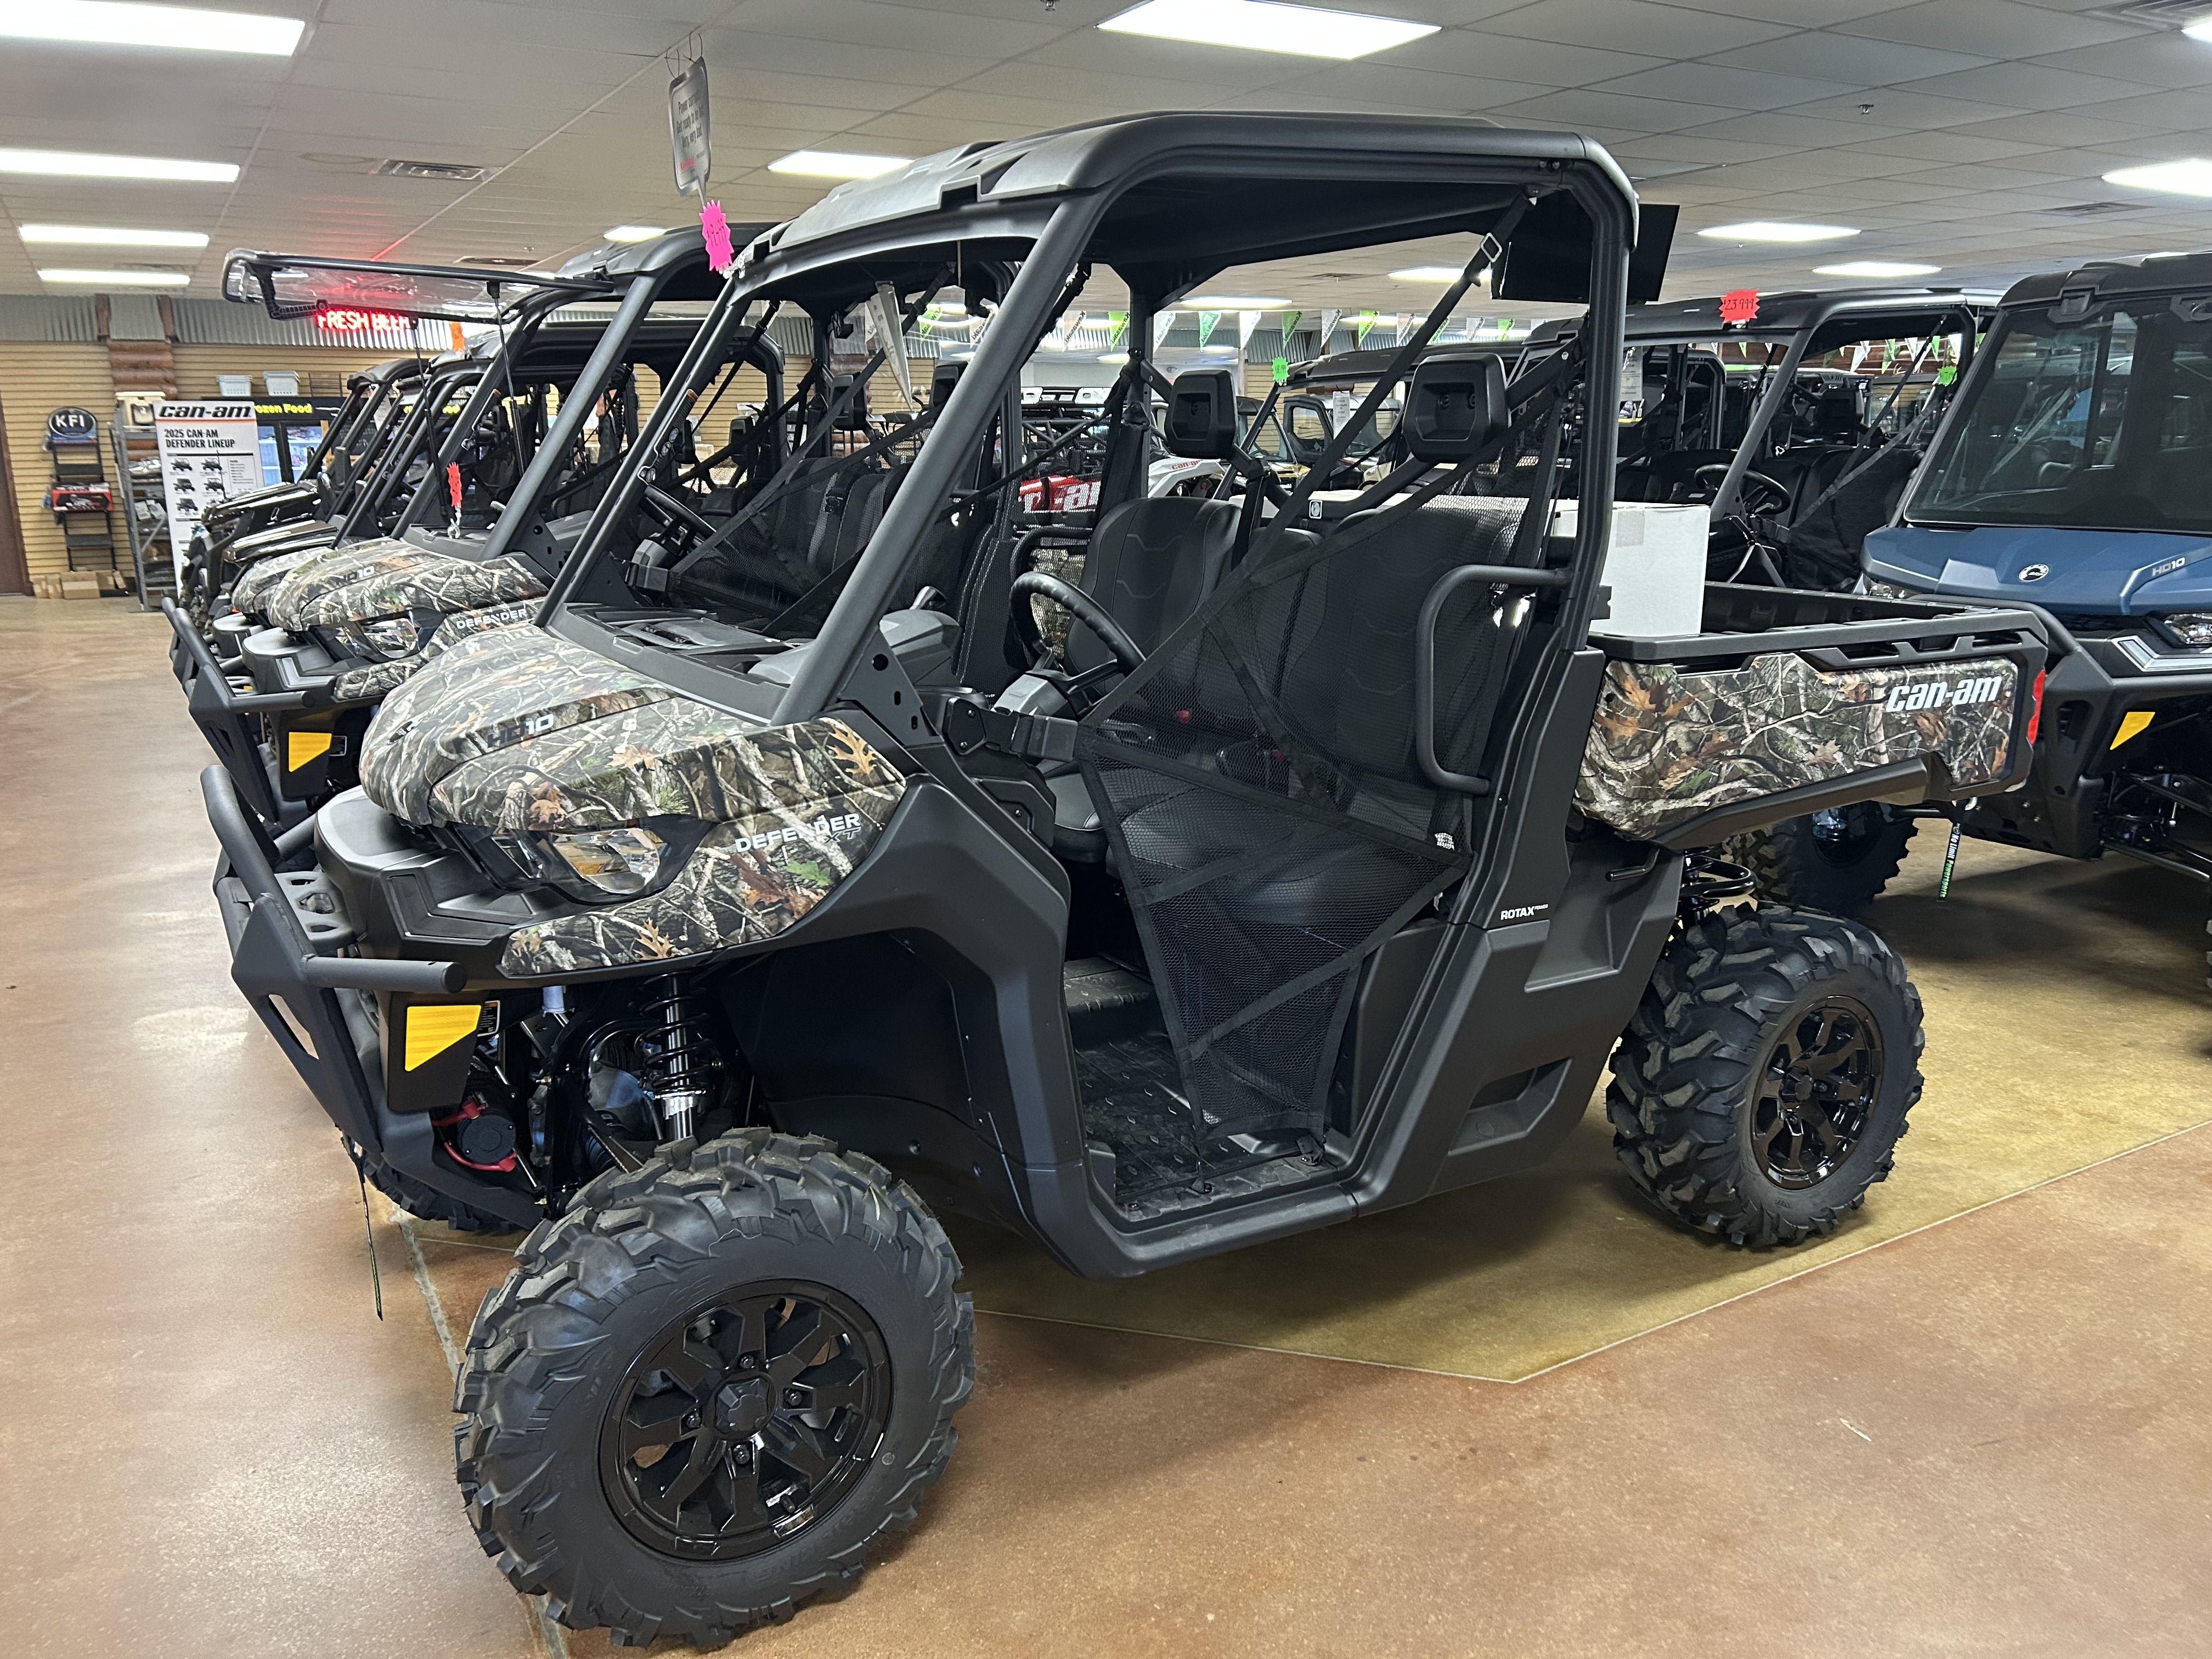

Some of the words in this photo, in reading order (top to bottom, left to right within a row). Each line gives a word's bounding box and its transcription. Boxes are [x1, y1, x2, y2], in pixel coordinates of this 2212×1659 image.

[317, 311, 368, 330] FRESH
[159, 405, 252, 417] can-am
[283, 403, 313, 414] Food
[55, 414, 85, 428] KFI
[164, 429, 184, 438] 2025
[186, 429, 219, 438] CAN-AM
[166, 438, 206, 448] DEFENDER
[207, 438, 236, 448] LINEUP
[2152, 556, 2186, 577] HD10
[456, 608, 527, 629] DEFENDER
[1885, 675, 2002, 713] can-am
[487, 714, 554, 748] HD10
[735, 813, 861, 853] DEFENDER
[823, 826, 862, 844] XT
[1950, 833, 1960, 843] No
[1947, 843, 1957, 859] Limit
[1939, 859, 1954, 898] Powersports
[1500, 906, 1534, 921] ROTAX
